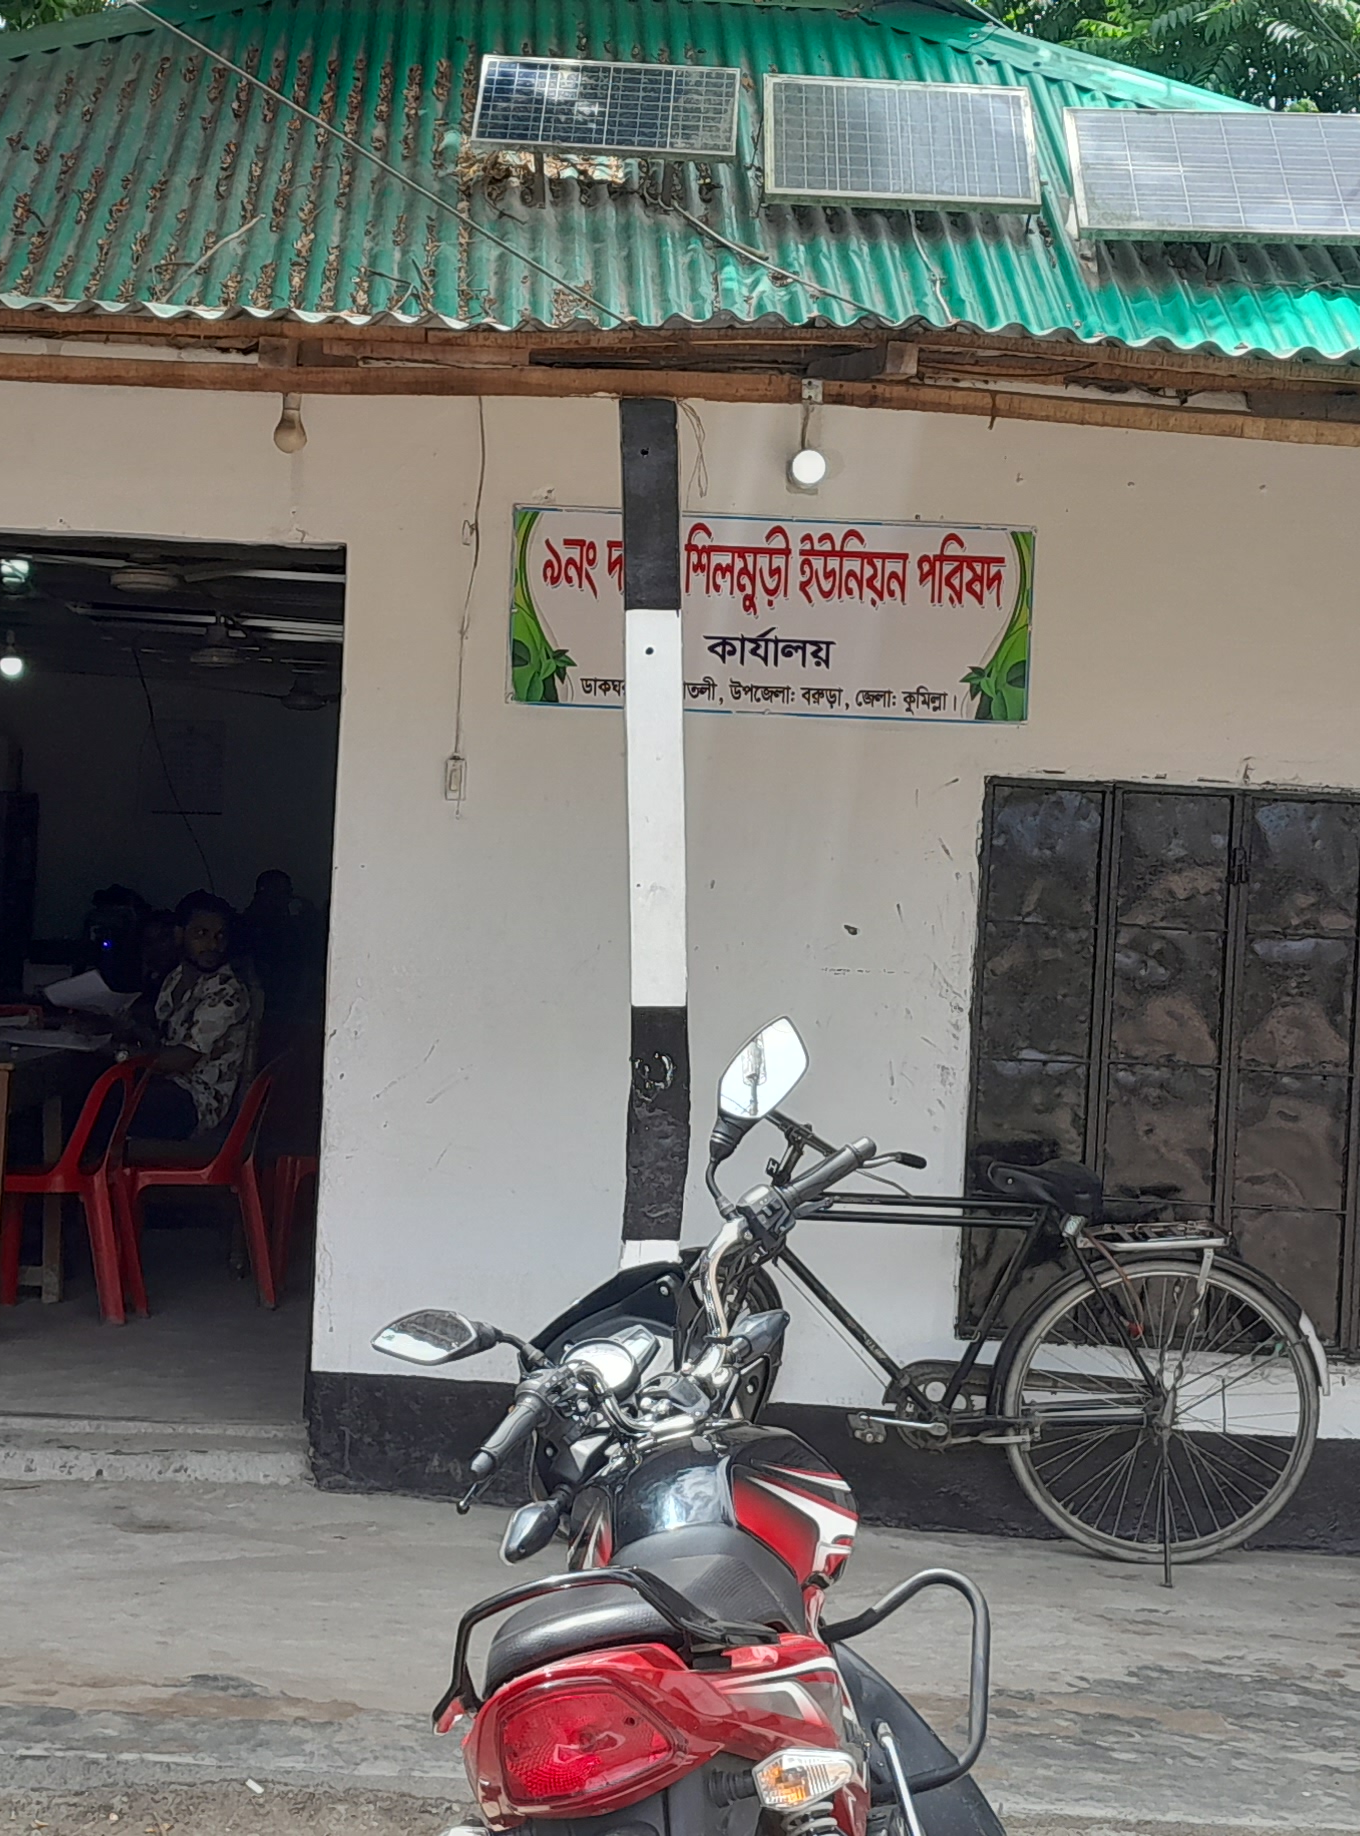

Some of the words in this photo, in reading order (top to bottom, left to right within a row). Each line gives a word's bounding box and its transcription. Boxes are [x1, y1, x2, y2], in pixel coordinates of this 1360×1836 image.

[543, 538, 598, 599] ৯নং
[685, 523, 792, 615] শিলমুড়ী
[799, 529, 909, 607] ইউনিয়ন
[917, 533, 1005, 607] পরিষদ
[704, 628, 836, 668] কার্যালয়
[580, 677, 626, 696] ডাকঘ
